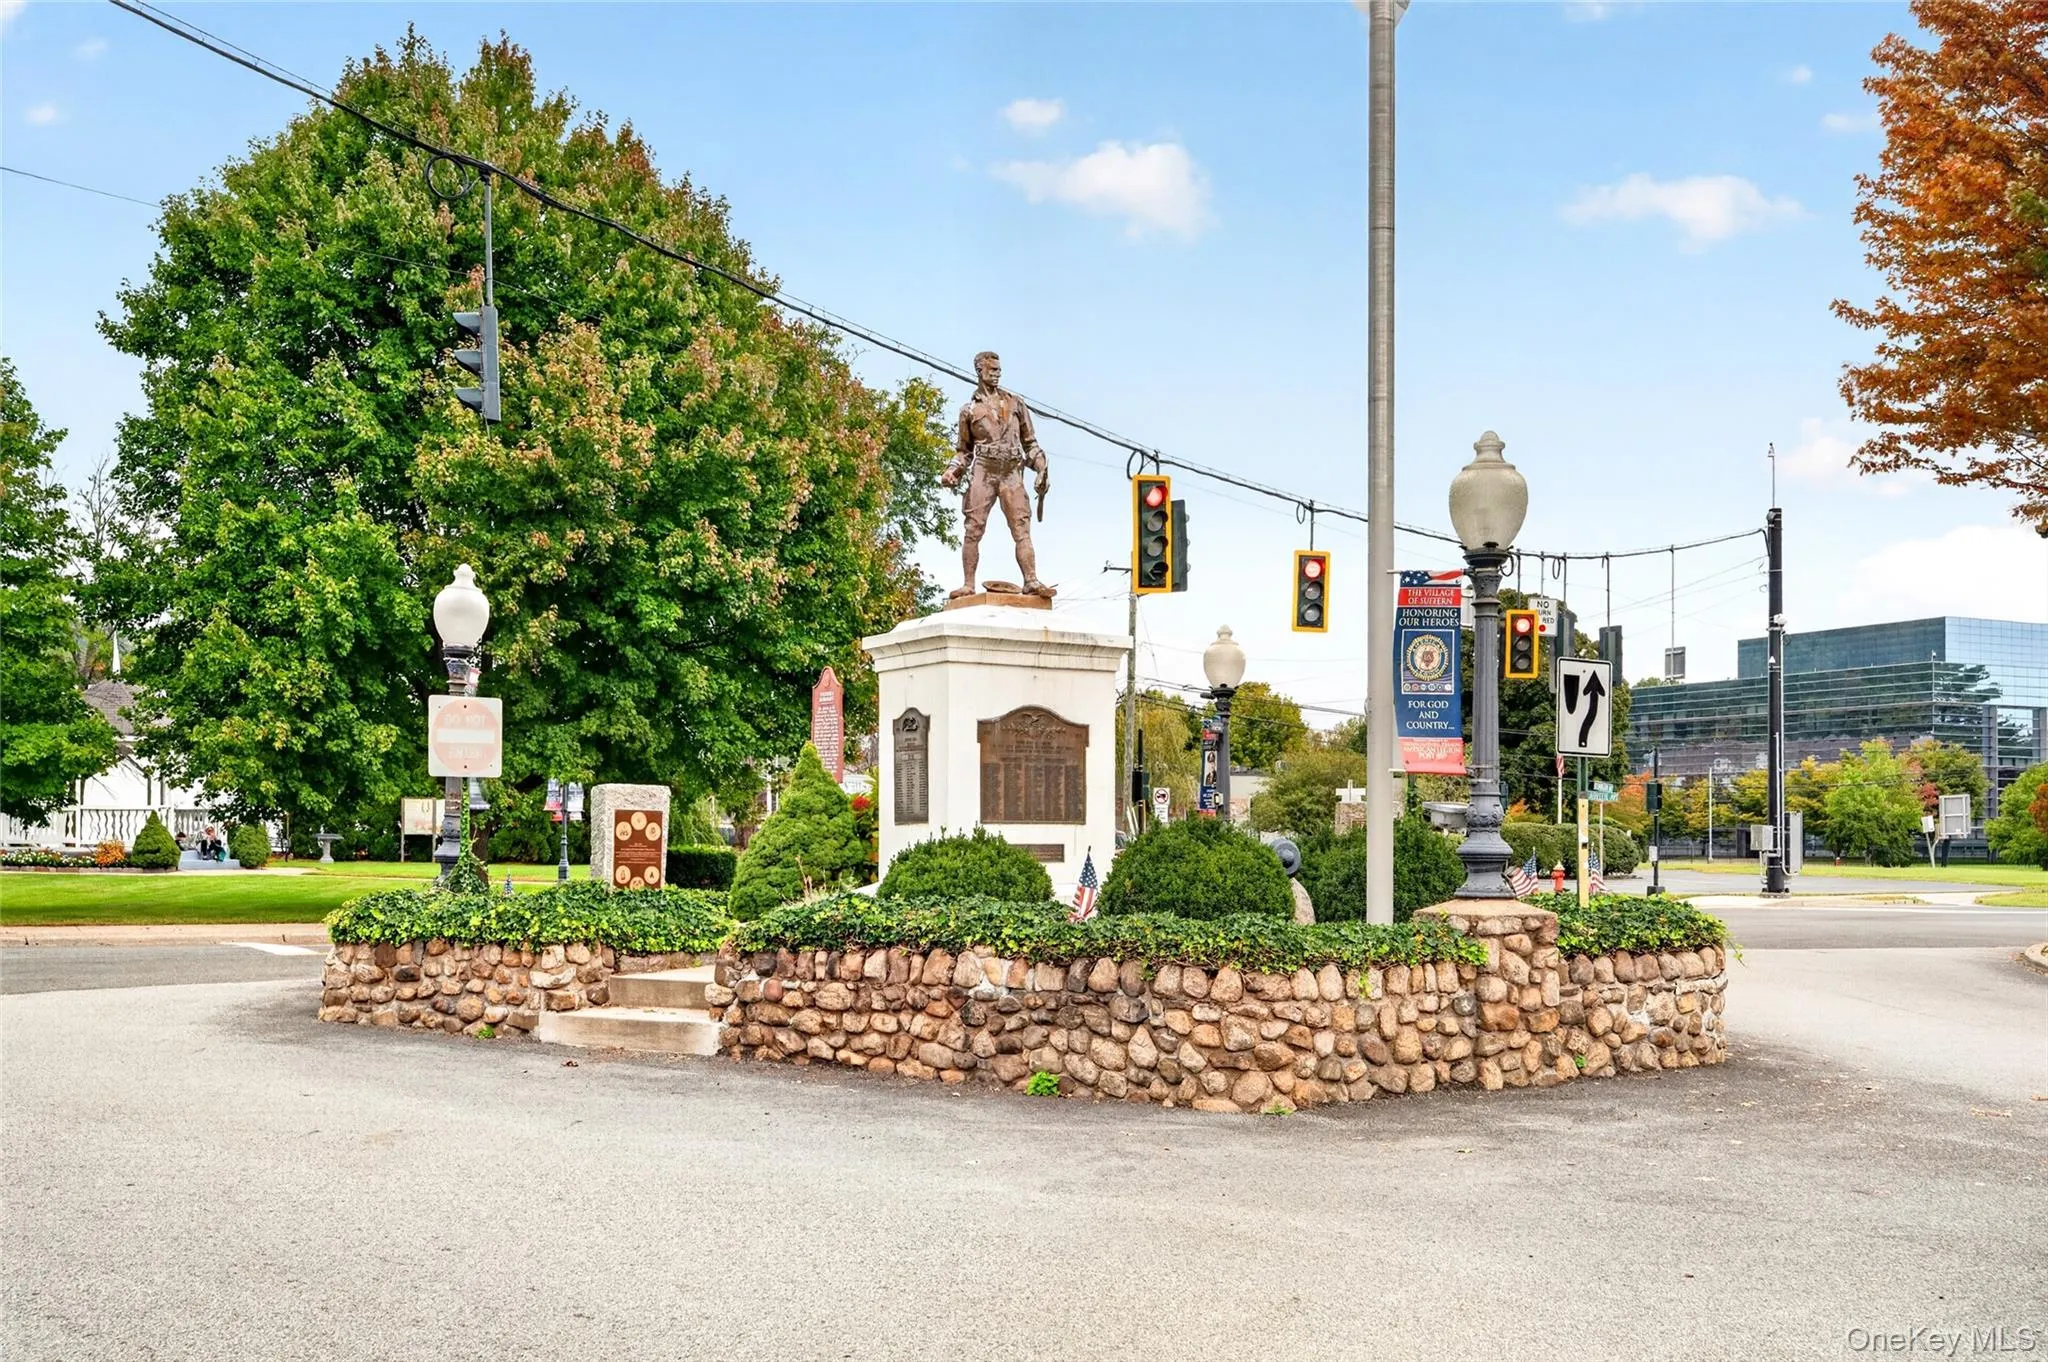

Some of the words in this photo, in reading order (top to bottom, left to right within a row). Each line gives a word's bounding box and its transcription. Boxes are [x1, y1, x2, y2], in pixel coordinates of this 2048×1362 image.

[1408, 589, 1422, 597] THE
[1423, 589, 1455, 597] VILLAGE
[1408, 597, 1420, 605] OF
[1420, 597, 1453, 605] SUFFERN
[1402, 608, 1458, 617] HONORING
[1399, 617, 1420, 627] OUR
[1422, 618, 1460, 627] HEROES
[1408, 700, 1427, 709] FOR
[1427, 700, 1449, 709] GOD
[1419, 711, 1439, 719] AND
